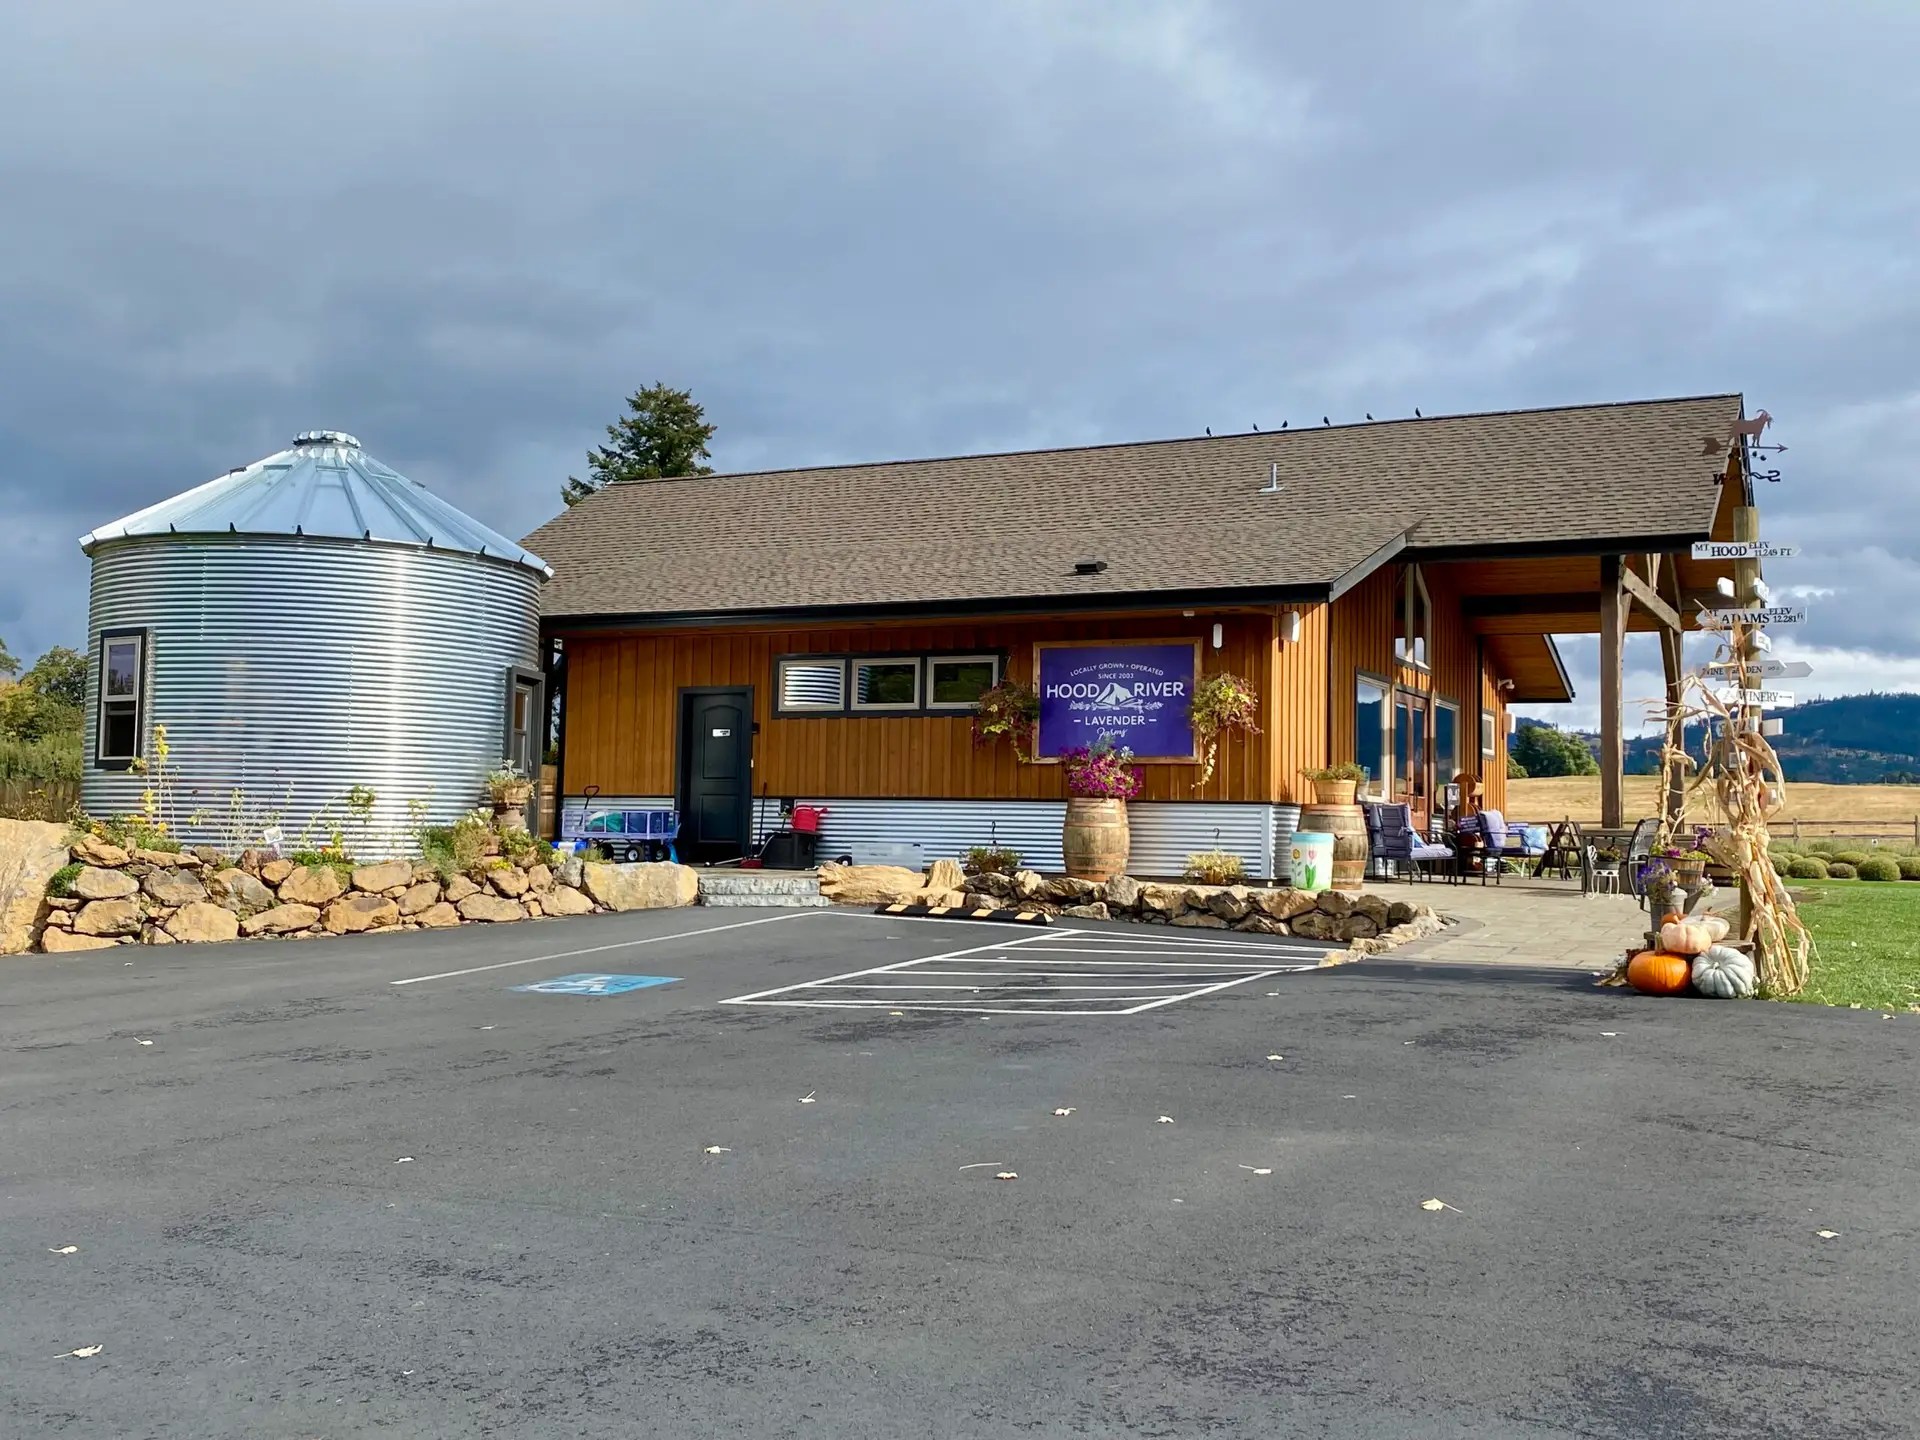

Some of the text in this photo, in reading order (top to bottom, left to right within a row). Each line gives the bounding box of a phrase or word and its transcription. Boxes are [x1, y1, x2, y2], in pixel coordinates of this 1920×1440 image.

[1695, 543, 1747, 557] MT HOOD
[1748, 541, 1770, 549] ELEV
[1780, 548, 1792, 556] FT
[1769, 607, 1792, 615] ELEV
[1722, 613, 1769, 624] ADAMS
[1070, 662, 1164, 677] LOCALLY GROWN OPERATED
[1046, 682, 1185, 698] HOOD RIVER
[1739, 690, 1779, 702] WINERY
[1084, 716, 1145, 726] LAVENDER
